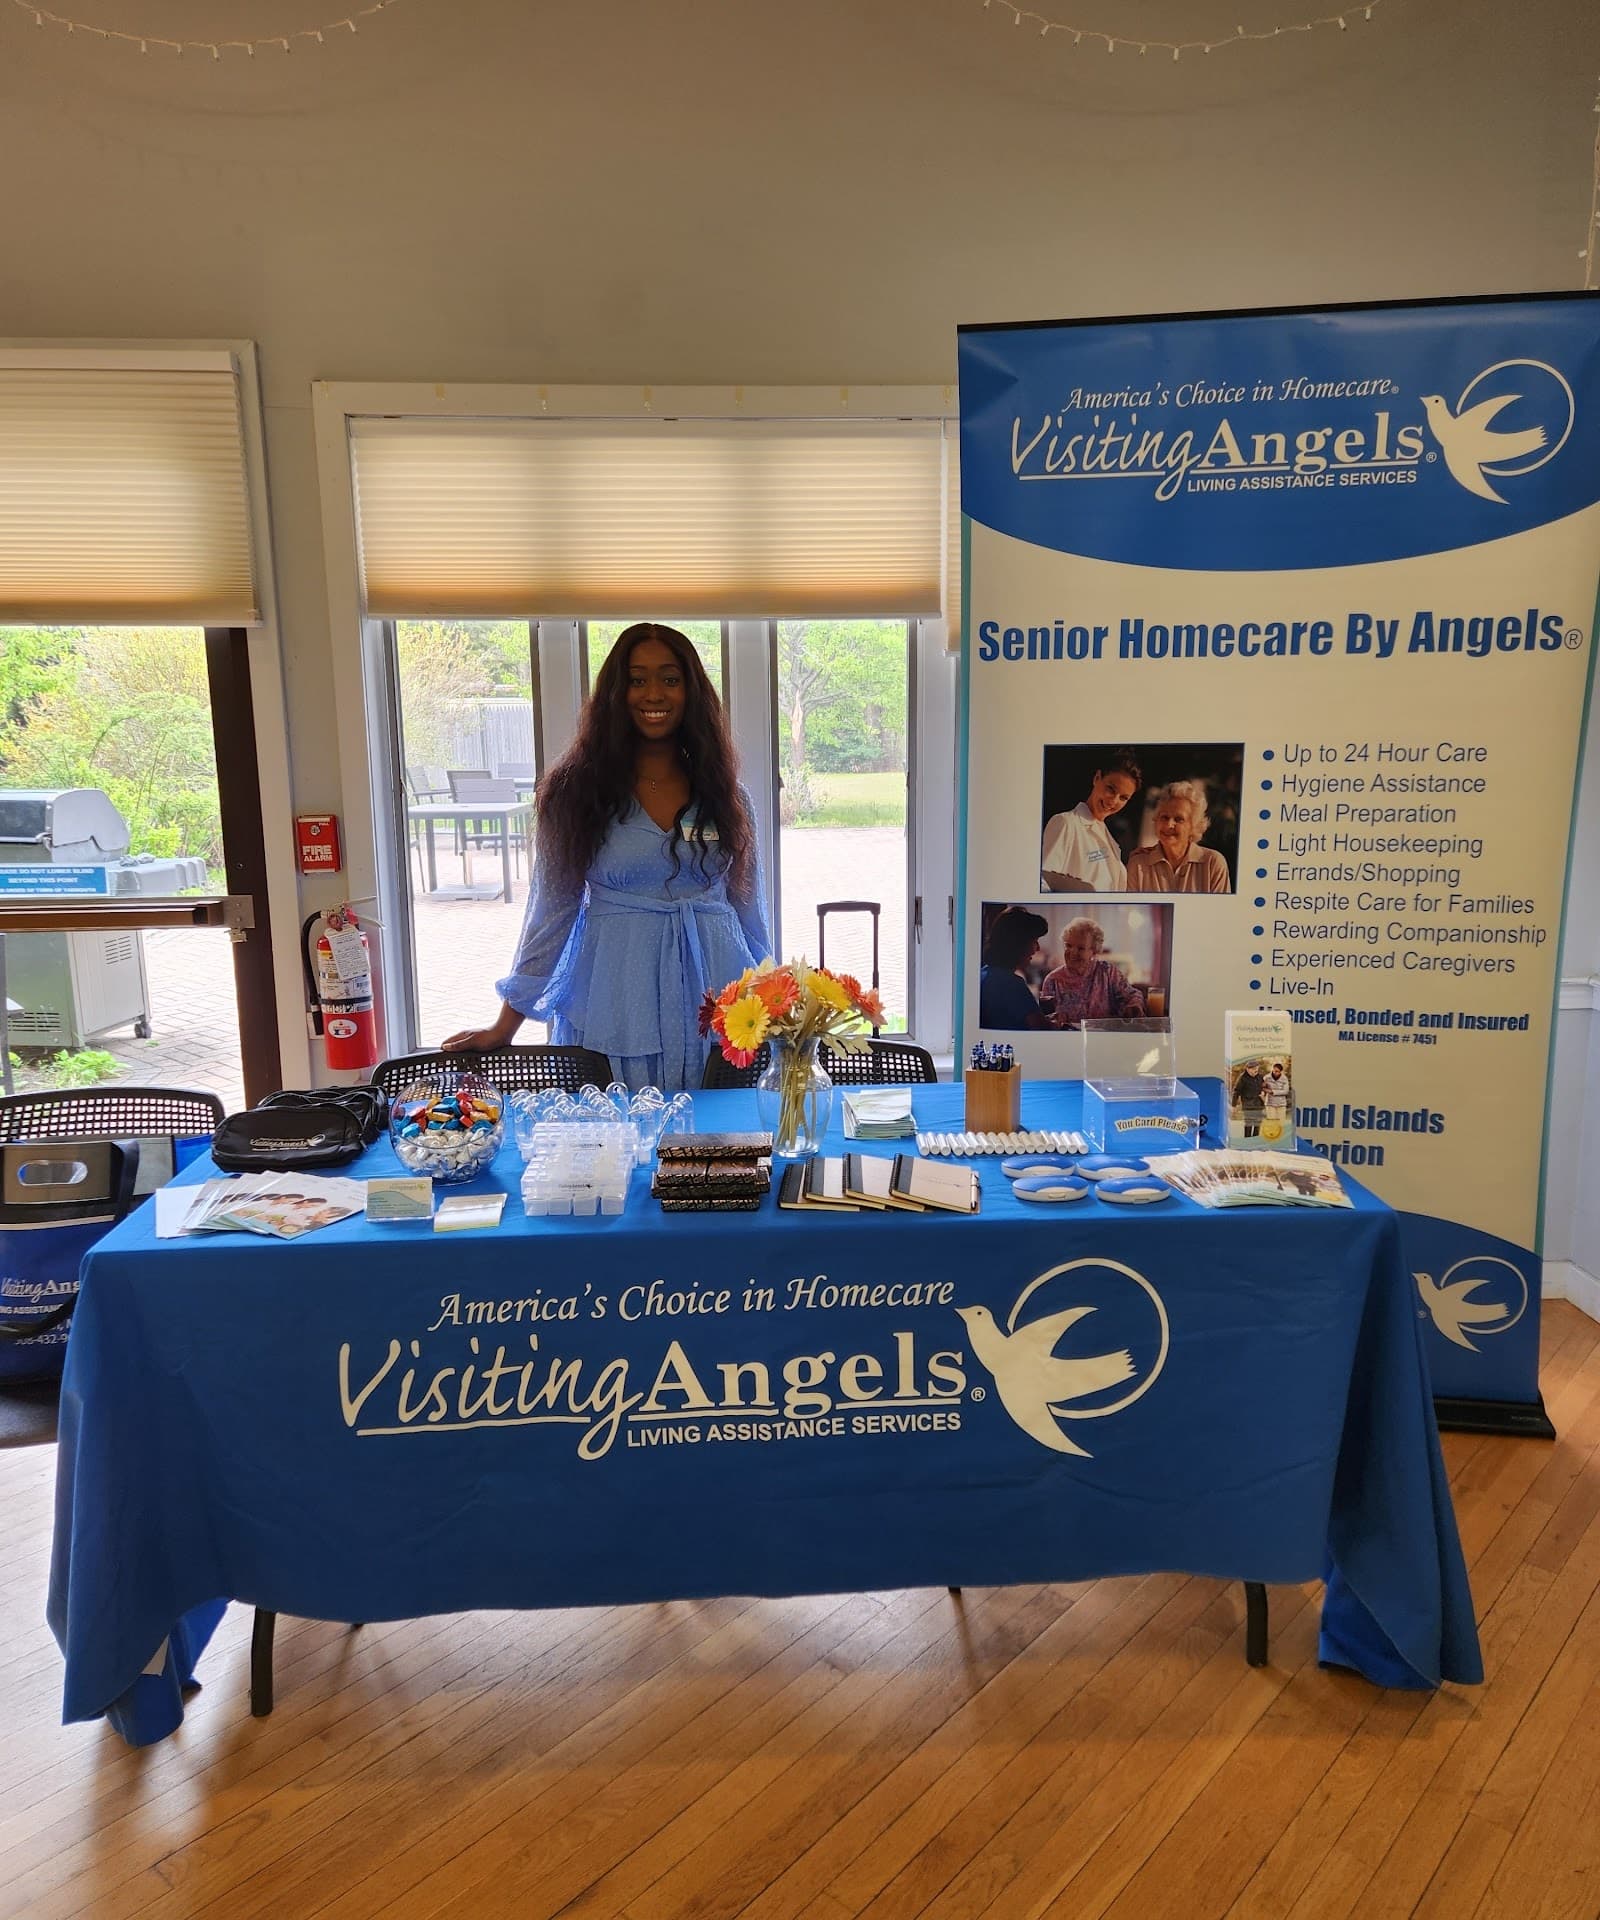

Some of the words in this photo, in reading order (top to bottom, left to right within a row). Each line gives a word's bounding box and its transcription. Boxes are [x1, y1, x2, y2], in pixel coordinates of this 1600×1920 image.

[1062, 382, 1168, 411] America's
[1175, 379, 1246, 406] Choice
[1252, 379, 1275, 402] in
[1010, 414, 1203, 501] Visiting
[1187, 475, 1237, 493] LIVING
[1240, 473, 1335, 490] ASSISTANCE
[1339, 469, 1417, 487] SERVICES
[979, 619, 1109, 663] Senior
[1119, 616, 1333, 659] Homecare
[1347, 613, 1400, 659] By
[1283, 743, 1312, 767] Up
[1319, 743, 1338, 763] to
[1344, 743, 1369, 762] 24
[1377, 742, 1429, 762] Hour
[1436, 742, 1488, 762] Care
[1281, 774, 1365, 798] Hygiene
[1370, 773, 1486, 793] Assistance
[1279, 803, 1328, 823] Meal
[1335, 803, 1457, 827] Preparation
[302, 845, 333, 856] FIRE
[1277, 833, 1327, 857] Light
[1333, 833, 1484, 859] Housekeeping
[1276, 862, 1461, 888] Errands/Shopping
[1275, 891, 1350, 915] Respite
[1356, 892, 1406, 912] Care
[1413, 892, 1442, 913] for
[1448, 894, 1535, 915] Families
[1273, 920, 1379, 945] Rewarding
[1387, 921, 1547, 948] Companionship
[1271, 948, 1395, 972] Experienced
[1402, 951, 1516, 976] Caregivers
[1269, 977, 1335, 996] Live-In
[1344, 1007, 1414, 1027] Bonded
[1418, 1011, 1454, 1029] and
[1458, 1012, 1530, 1031] Insured
[1338, 1030, 1355, 1042] MA
[1357, 1030, 1400, 1044] License
[1413, 1033, 1437, 1045] 7451
[1116, 1120, 1133, 1131] You
[1135, 1117, 1156, 1127] Card
[1342, 1104, 1446, 1135] Islands
[1304, 1139, 1386, 1167] arion
[41, 1279, 80, 1296] Ang
[428, 1285, 607, 1332] America's
[618, 1280, 731, 1322] Choice
[741, 1278, 776, 1313] in
[783, 1276, 956, 1313] Homecare
[338, 1334, 645, 1461] Visiting
[626, 1423, 703, 1449] LIVING
[706, 1416, 847, 1445] ASSISTANCE
[852, 1411, 962, 1437] SERVICES
